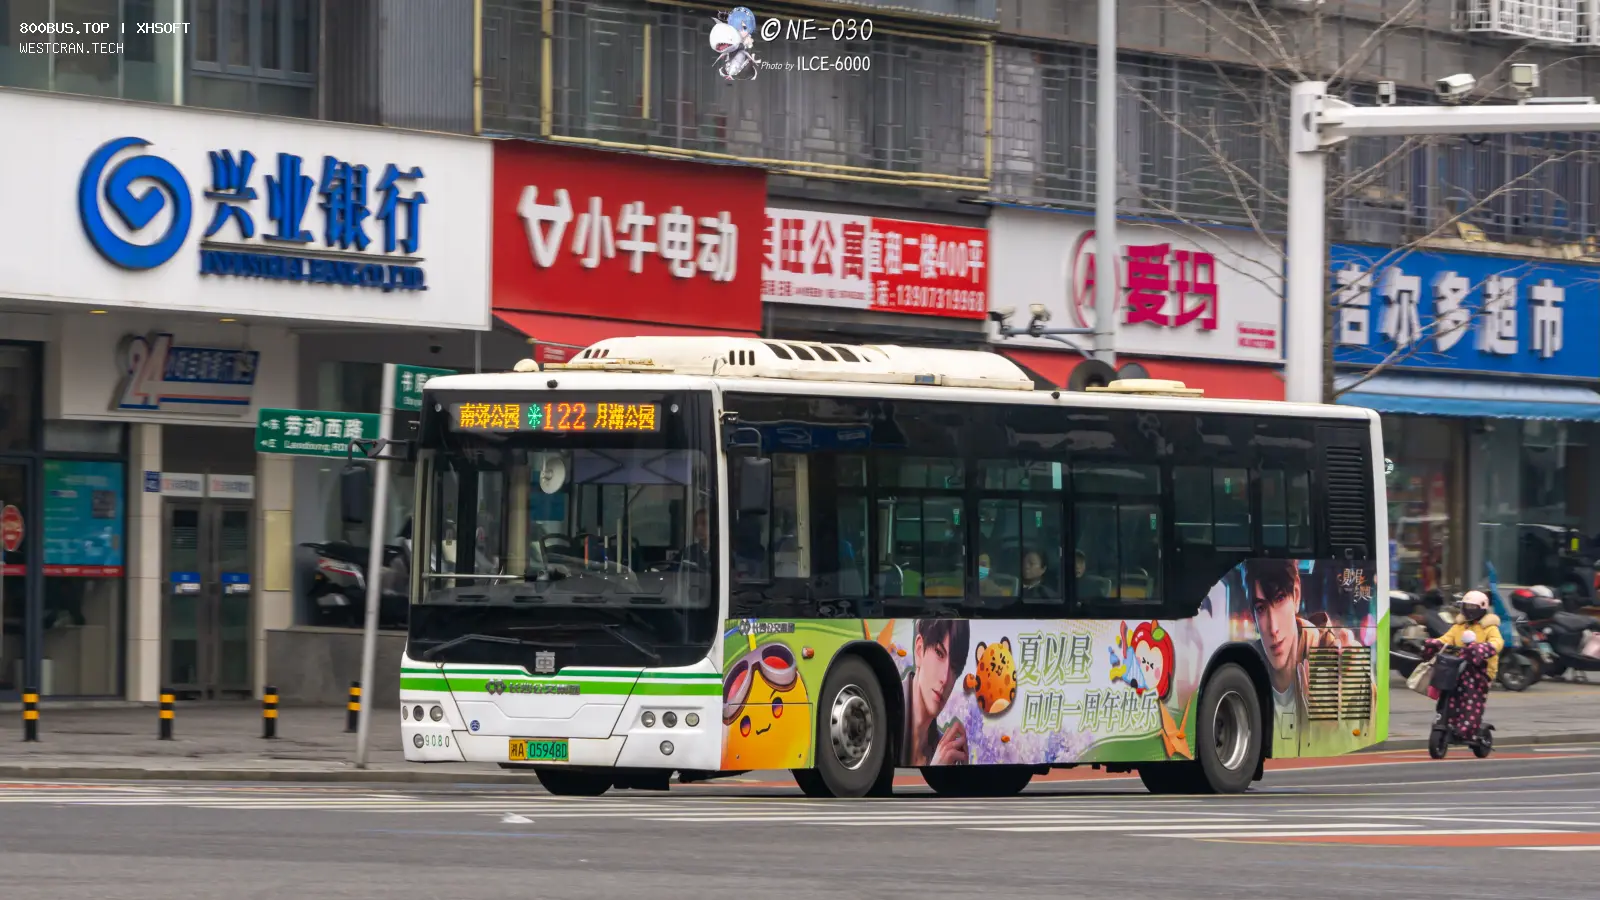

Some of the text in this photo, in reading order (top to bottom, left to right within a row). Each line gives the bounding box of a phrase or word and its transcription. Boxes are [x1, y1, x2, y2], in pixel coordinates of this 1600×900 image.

[203, 148, 428, 254] 兴业银行
[572, 197, 738, 281] 小牛电动
[1125, 243, 1219, 330] 爱玛
[284, 415, 364, 439] 劳动西路
[459, 403, 655, 430] 南郊公园 122 月湖公园
[1018, 631, 1092, 685] 夏以昼
[1021, 688, 1160, 733] 回归一周年快乐
[425, 735, 450, 748] 9080
